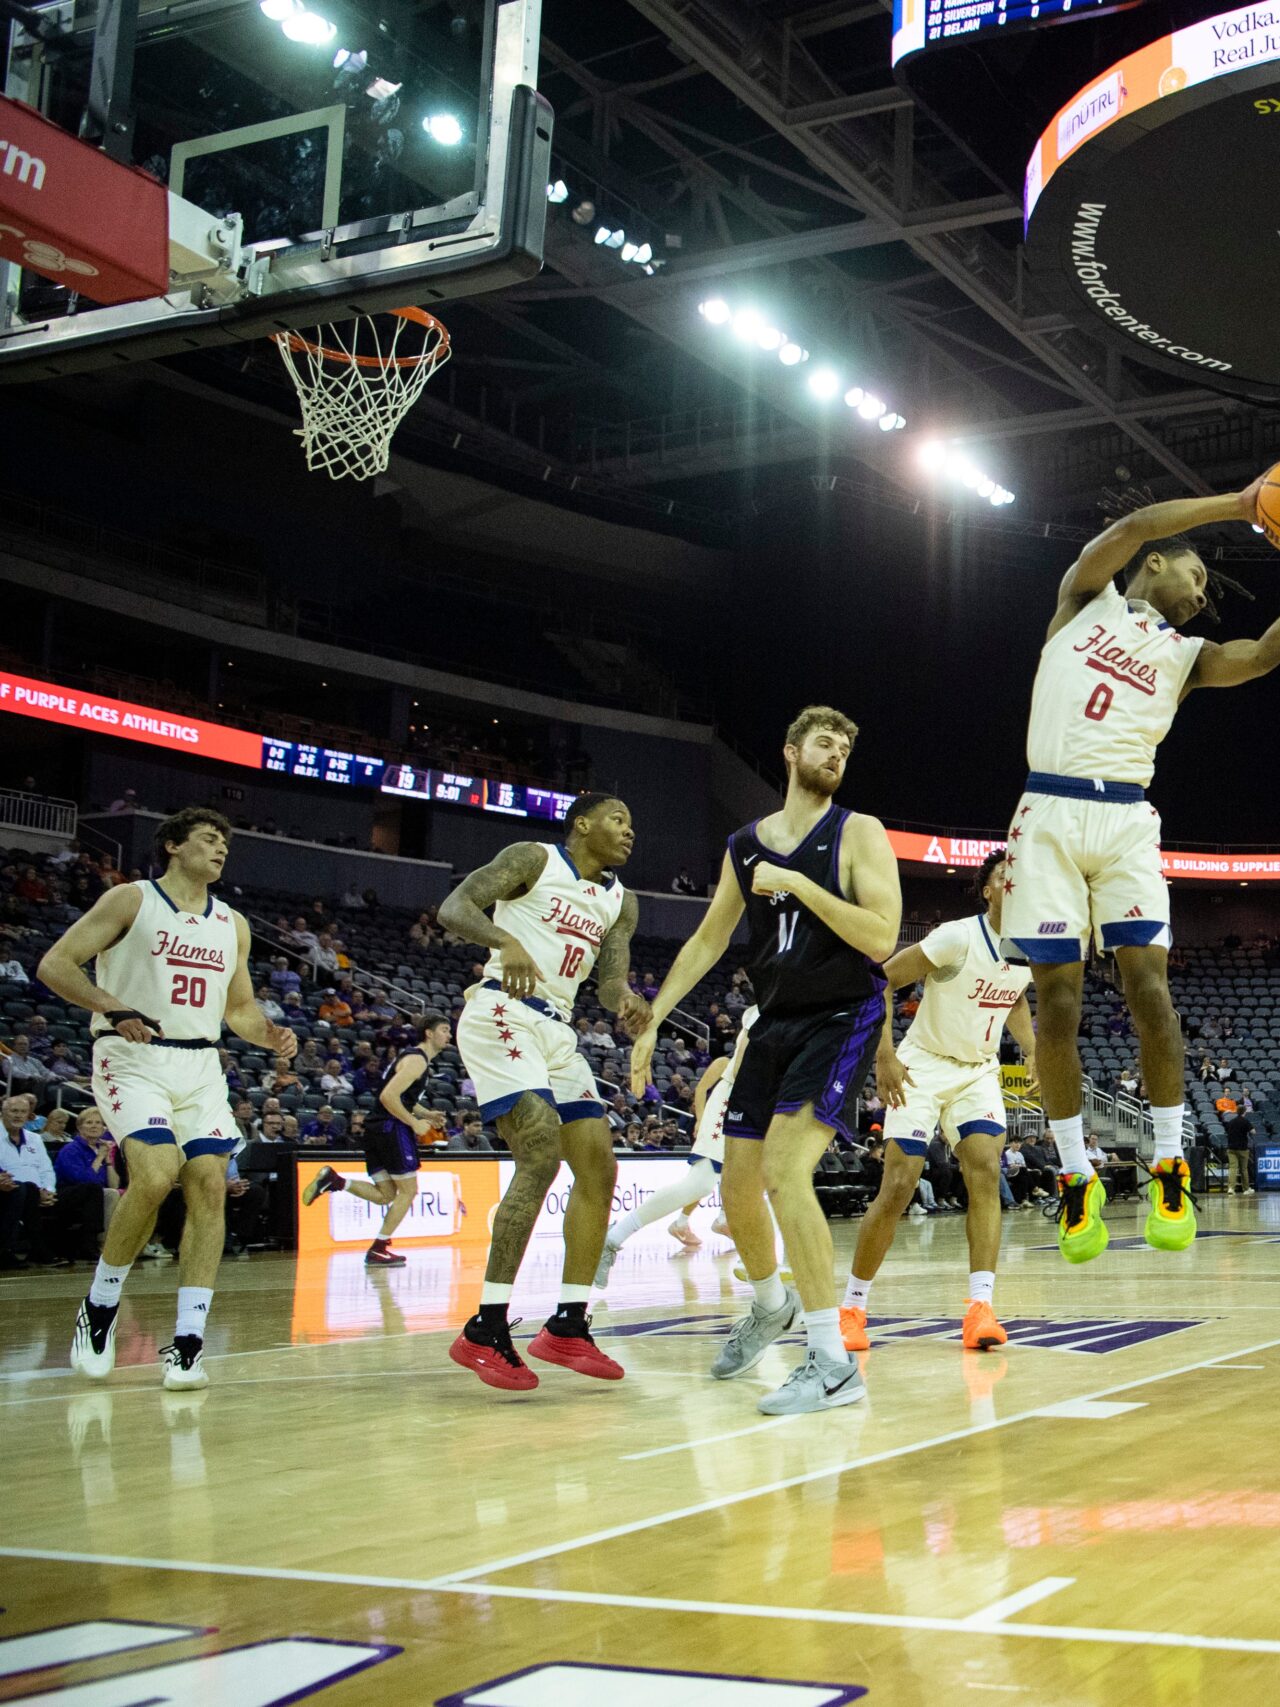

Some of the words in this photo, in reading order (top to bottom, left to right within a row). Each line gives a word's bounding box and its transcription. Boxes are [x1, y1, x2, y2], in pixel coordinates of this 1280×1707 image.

[928, 12, 942, 26] 20
[943, 1, 995, 23] SILVERSTEIN
[1211, 12, 1280, 41] Vodka.
[929, 26, 941, 40] 21
[943, 18, 981, 37] BELJAN
[1213, 38, 1256, 67] Real
[1071, 202, 1233, 372] www.fordcenter.com
[0, 683, 11, 698] F
[15, 687, 77, 715] PURPLE
[79, 703, 119, 725] ACES
[122, 713, 199, 743] ATHLETICS
[1084, 683, 1115, 722] 0
[398, 771, 415, 789] 19
[436, 784, 460, 801] 9:01
[1173, 859, 1229, 872] BUILDING
[1037, 921, 1068, 935] UIC
[151, 930, 225, 967] Flames
[558, 943, 585, 979] 10
[171, 973, 207, 1009] 20
[985, 1016, 995, 1042] 1
